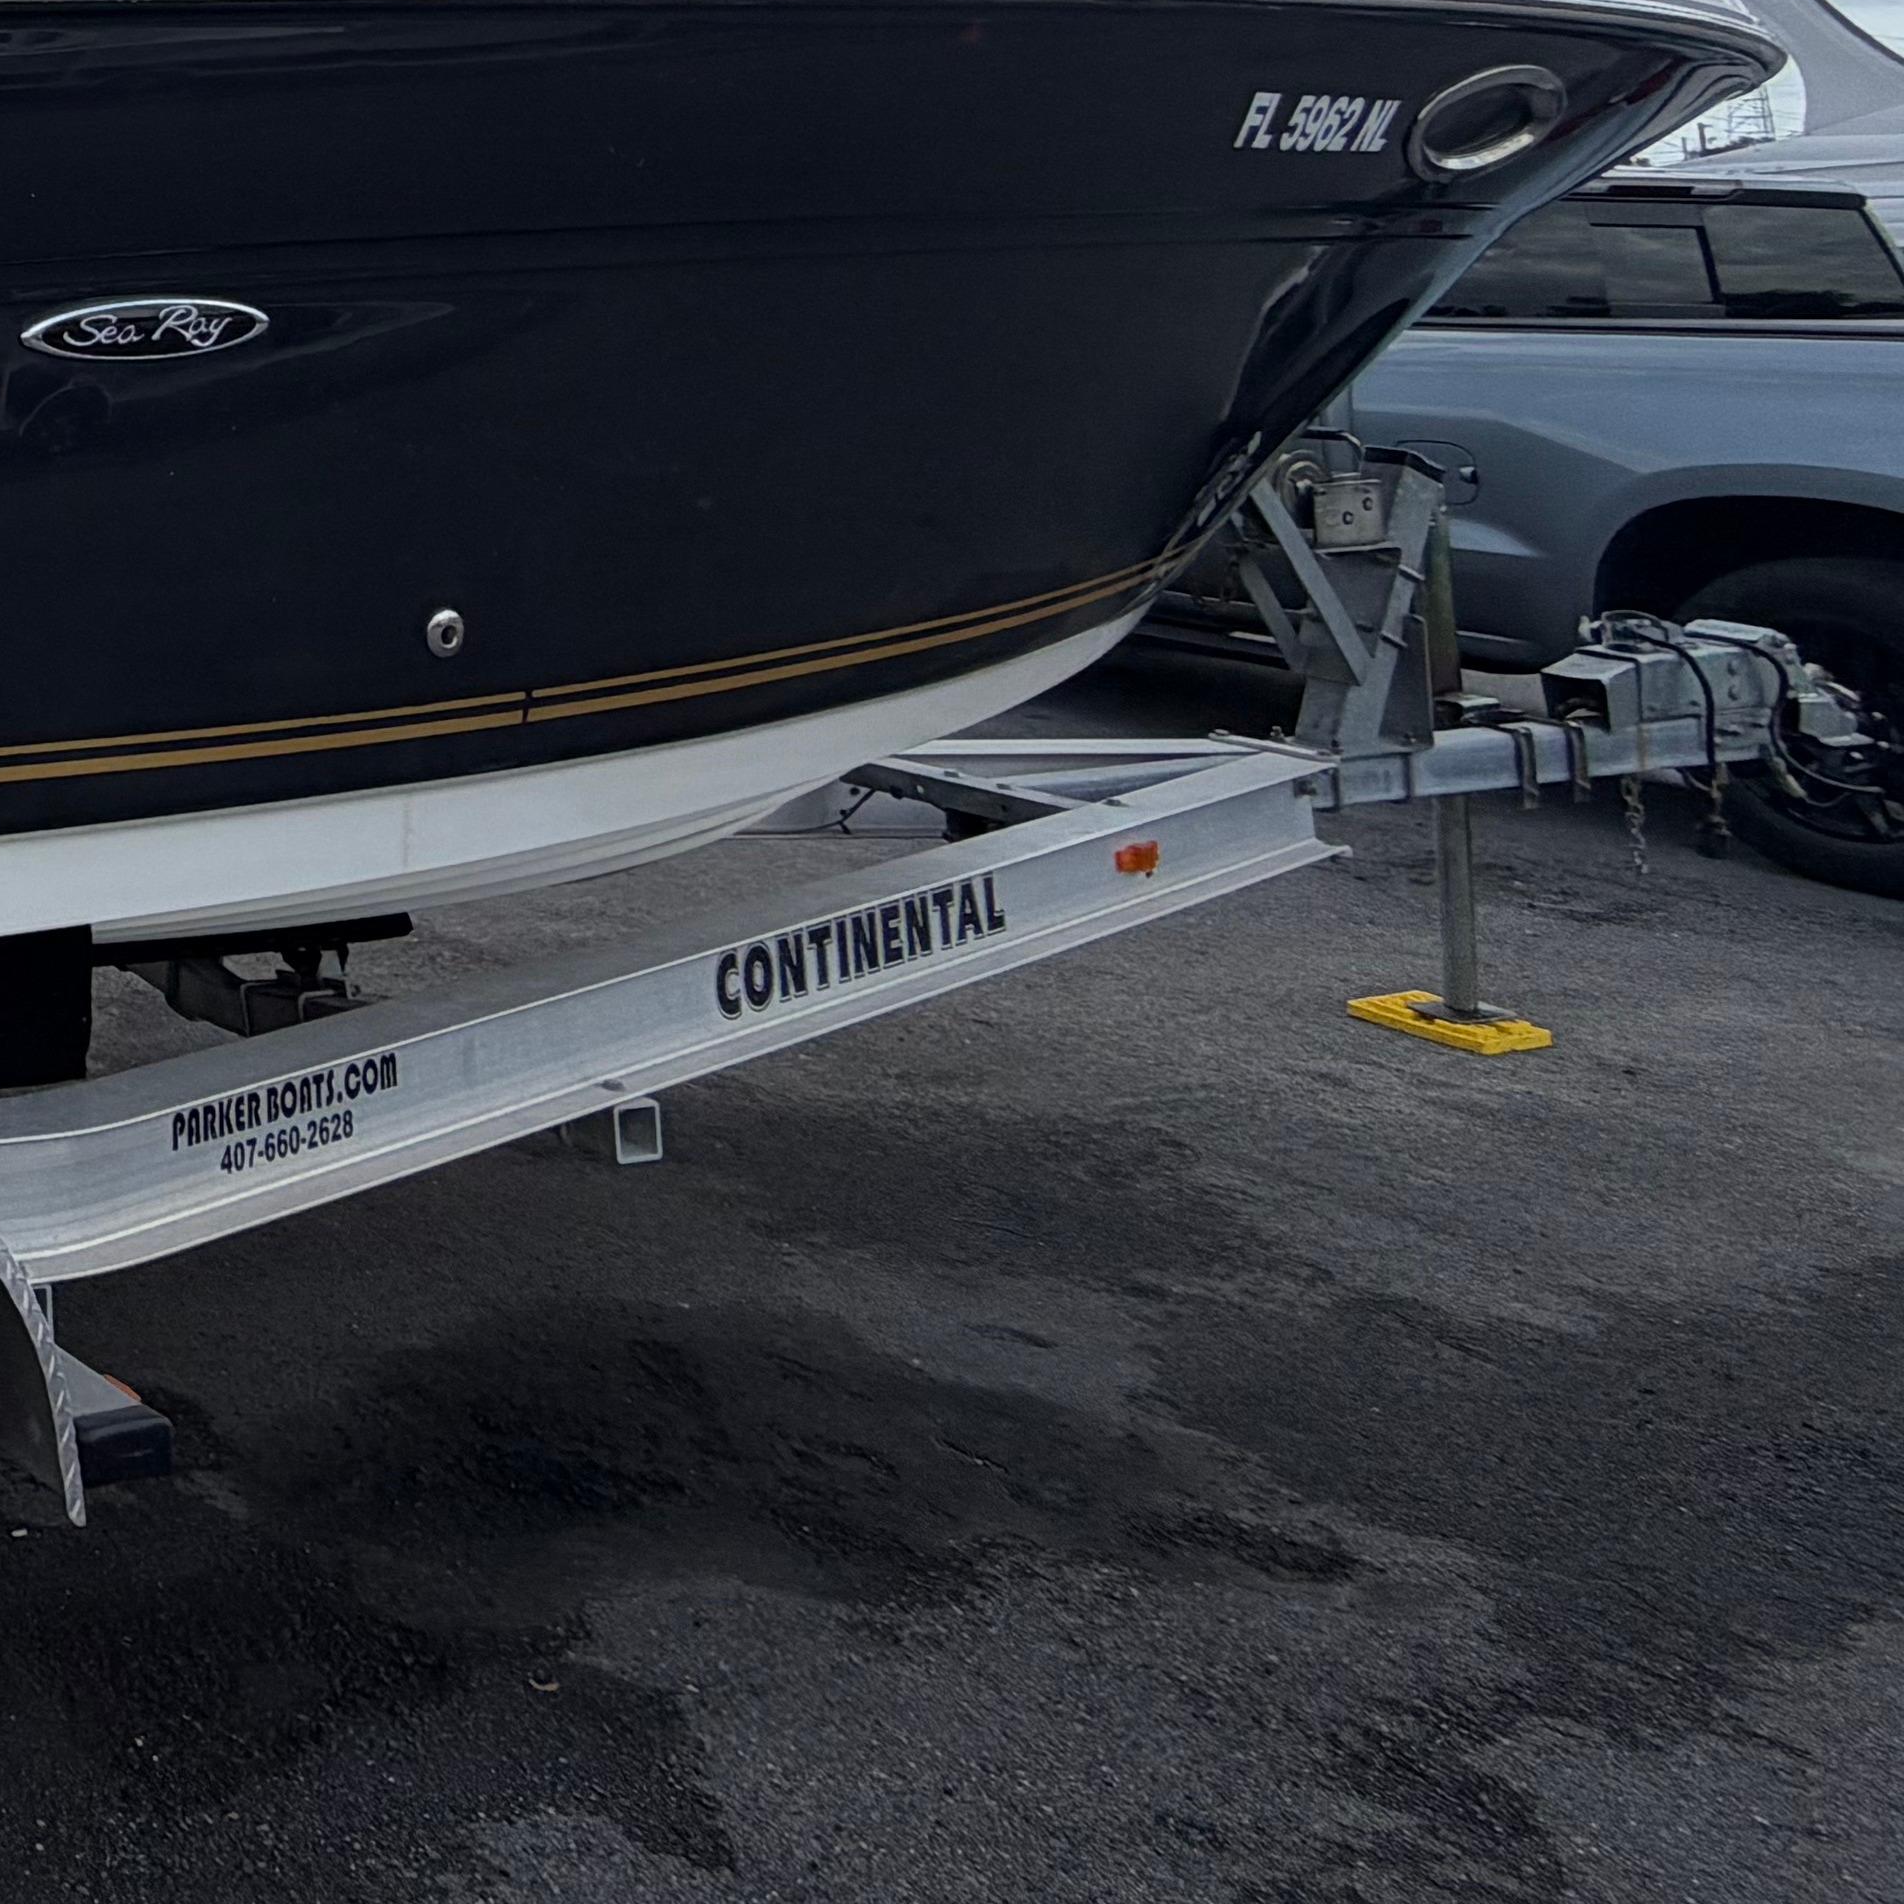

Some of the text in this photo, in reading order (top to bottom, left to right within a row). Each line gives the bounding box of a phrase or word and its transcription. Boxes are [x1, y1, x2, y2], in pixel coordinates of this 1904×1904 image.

[1233, 91, 1402, 152] FL 5962 NL
[63, 305, 232, 347] Sea Ray
[715, 872, 1007, 1020] CONTINENTAL
[172, 1092, 262, 1151] PARKER
[220, 1109, 354, 1175] 407-660-2628
